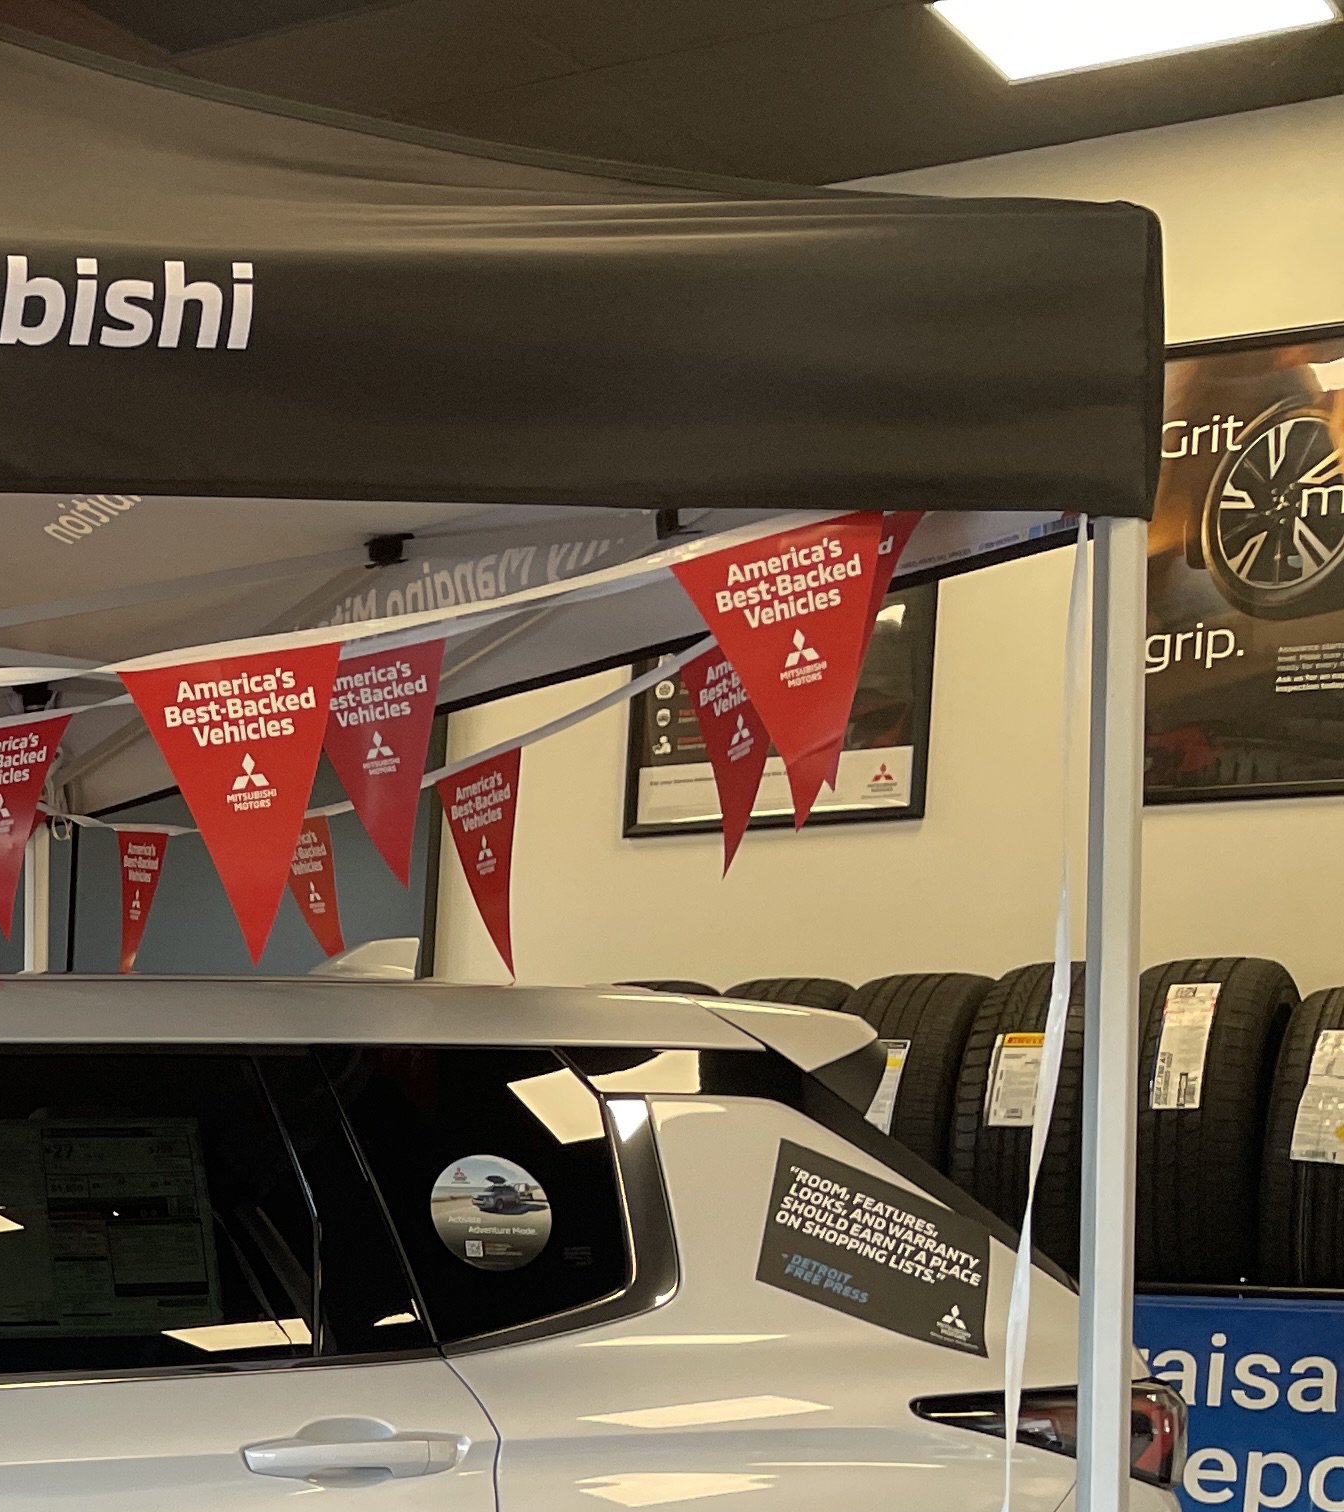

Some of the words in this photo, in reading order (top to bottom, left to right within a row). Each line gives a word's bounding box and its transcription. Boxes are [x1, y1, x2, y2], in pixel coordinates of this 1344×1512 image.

[1161, 414, 1244, 459] Grit
[727, 537, 843, 586] America's
[715, 553, 862, 613] Best-Backed
[743, 587, 841, 629] Vehicles
[1145, 622, 1244, 674] grip.
[177, 667, 296, 703] America's
[699, 671, 741, 707] Best-B
[780, 661, 827, 681] MITSUBISHI
[787, 672, 822, 688] MOTORS
[163, 687, 317, 728] Best-Backed
[329, 675, 428, 711] est-Backed
[713, 687, 748, 717] Vehic
[192, 716, 295, 747] Vehicles
[336, 699, 411, 728] Vehicles
[362, 757, 400, 770] MITSUBISHI
[368, 763, 398, 776] MOTORS
[226, 788, 277, 803] MITSUBISHI
[450, 784, 511, 820] Best-Backed
[455, 771, 503, 801] America's
[234, 798, 271, 812] MOTORS
[462, 807, 502, 832] Vehicles
[789, 1183, 847, 1216] LOOKS,
[848, 1208, 886, 1230] AND
[888, 1221, 980, 1269] WARRANTY
[853, 1192, 939, 1238] FEATURES,
[775, 1210, 801, 1231] ON
[802, 1219, 888, 1264] SHOPPING
[780, 1196, 849, 1231] SHOULD
[849, 1226, 896, 1253] EARN
[897, 1240, 916, 1258] IT
[914, 1248, 927, 1262] A
[929, 1254, 982, 1286] PLACE
[784, 1265, 820, 1286] FREE
[823, 1277, 870, 1303] PRESS
[790, 1254, 853, 1283] DETROIT
